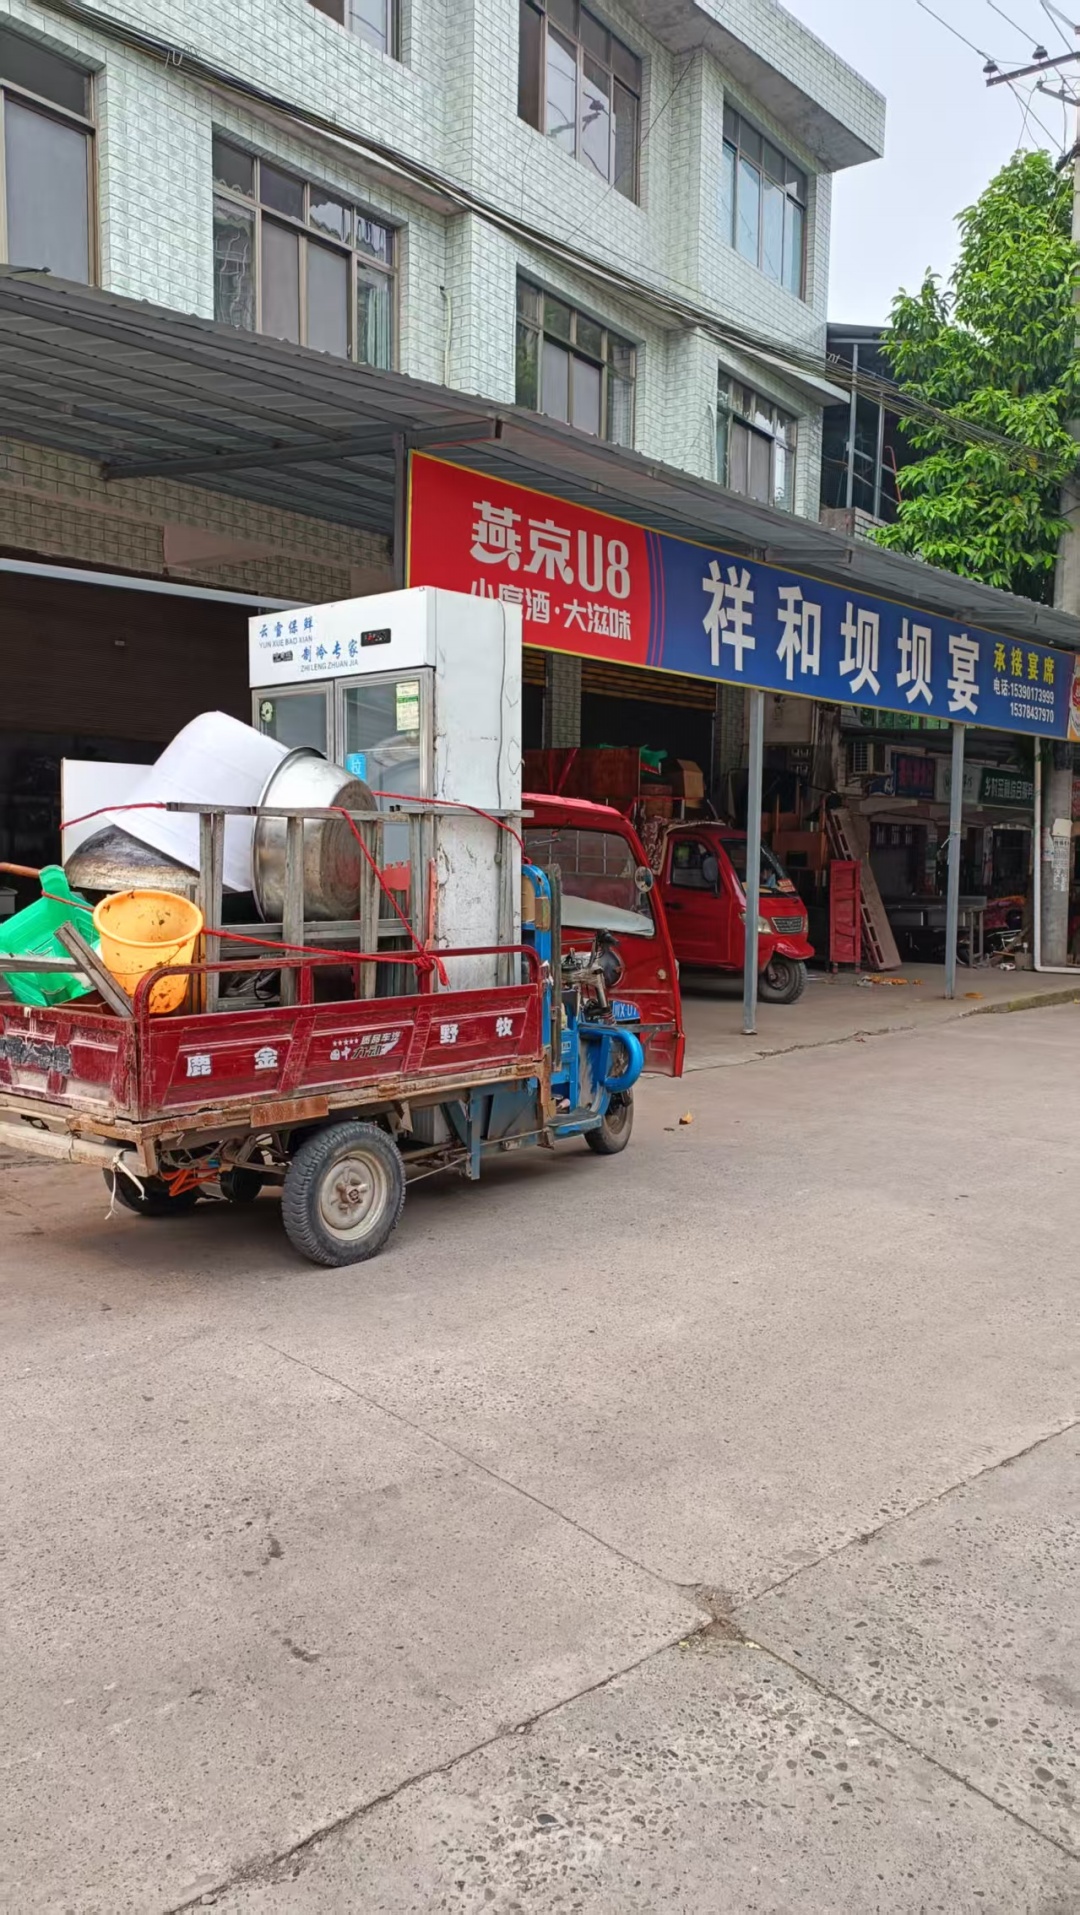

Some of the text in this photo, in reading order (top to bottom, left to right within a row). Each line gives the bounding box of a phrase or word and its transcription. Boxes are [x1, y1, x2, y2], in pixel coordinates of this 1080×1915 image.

[470, 500, 631, 599] 燕京U8
[259, 635, 312, 649] YUN XUE BAO XIAN
[702, 560, 980, 715] 祥和坝坝宴
[301, 639, 358, 662] 制冷专家
[300, 658, 359, 672] ZHI LENG ZHUAN JIA
[993, 642, 1054, 685] 承接宴席
[1010, 702, 1055, 724] 15378437970
